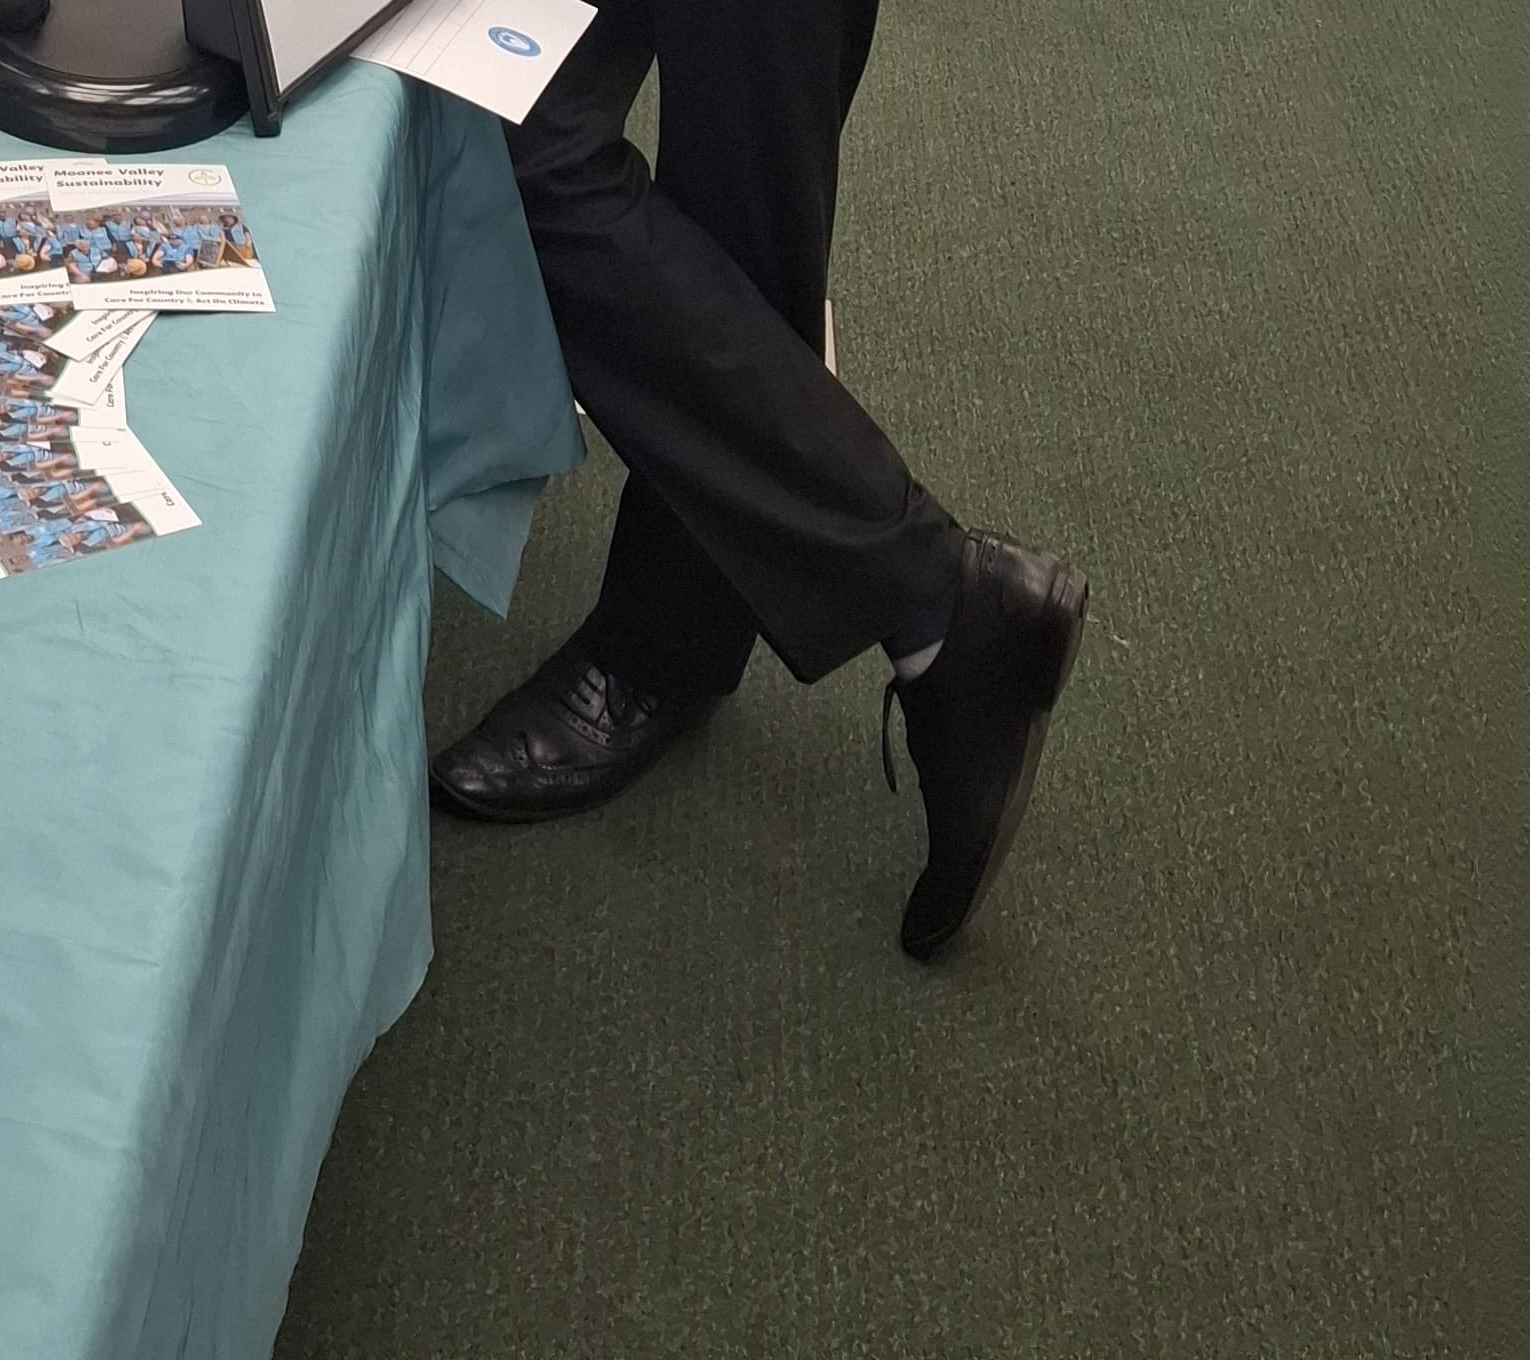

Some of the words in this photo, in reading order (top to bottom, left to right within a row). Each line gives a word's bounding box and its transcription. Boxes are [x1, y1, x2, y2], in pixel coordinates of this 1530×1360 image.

[0, 163, 44, 173] Valley
[54, 168, 114, 178] Moonee
[119, 168, 164, 178] Valley
[56, 178, 163, 188] Sustainability
[90, 366, 103, 383] Care
